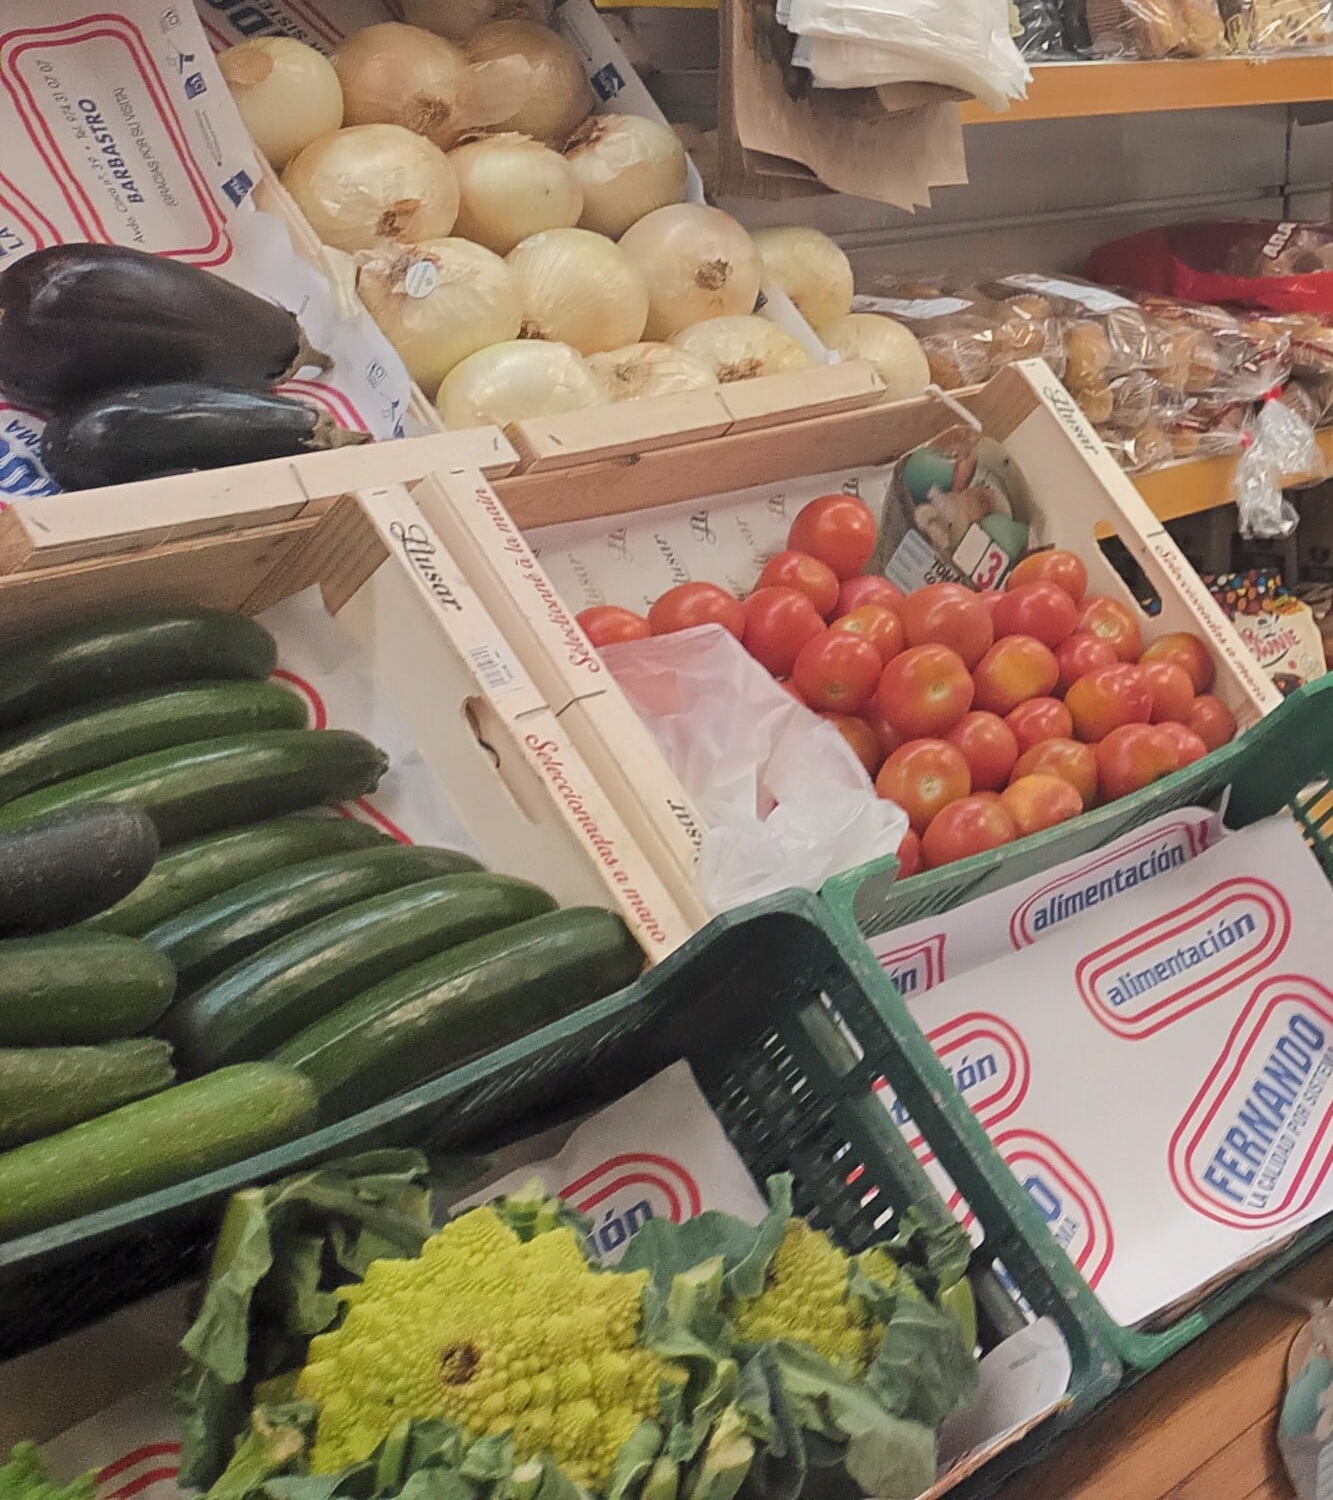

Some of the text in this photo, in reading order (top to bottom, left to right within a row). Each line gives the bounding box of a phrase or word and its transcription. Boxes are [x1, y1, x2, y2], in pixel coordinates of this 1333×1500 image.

[77, 98, 146, 206] BARBASTRO
[525, 733, 667, 945] Seleccionadas a mano
[1033, 841, 1186, 933] alimentación
[1106, 911, 1257, 1009] alimentación
[1200, 1012, 1326, 1206] FERNANDO
[1247, 1192, 1268, 1210] LA
[1258, 1135, 1297, 1193] CALIDAD
[1288, 1107, 1311, 1136] POR
